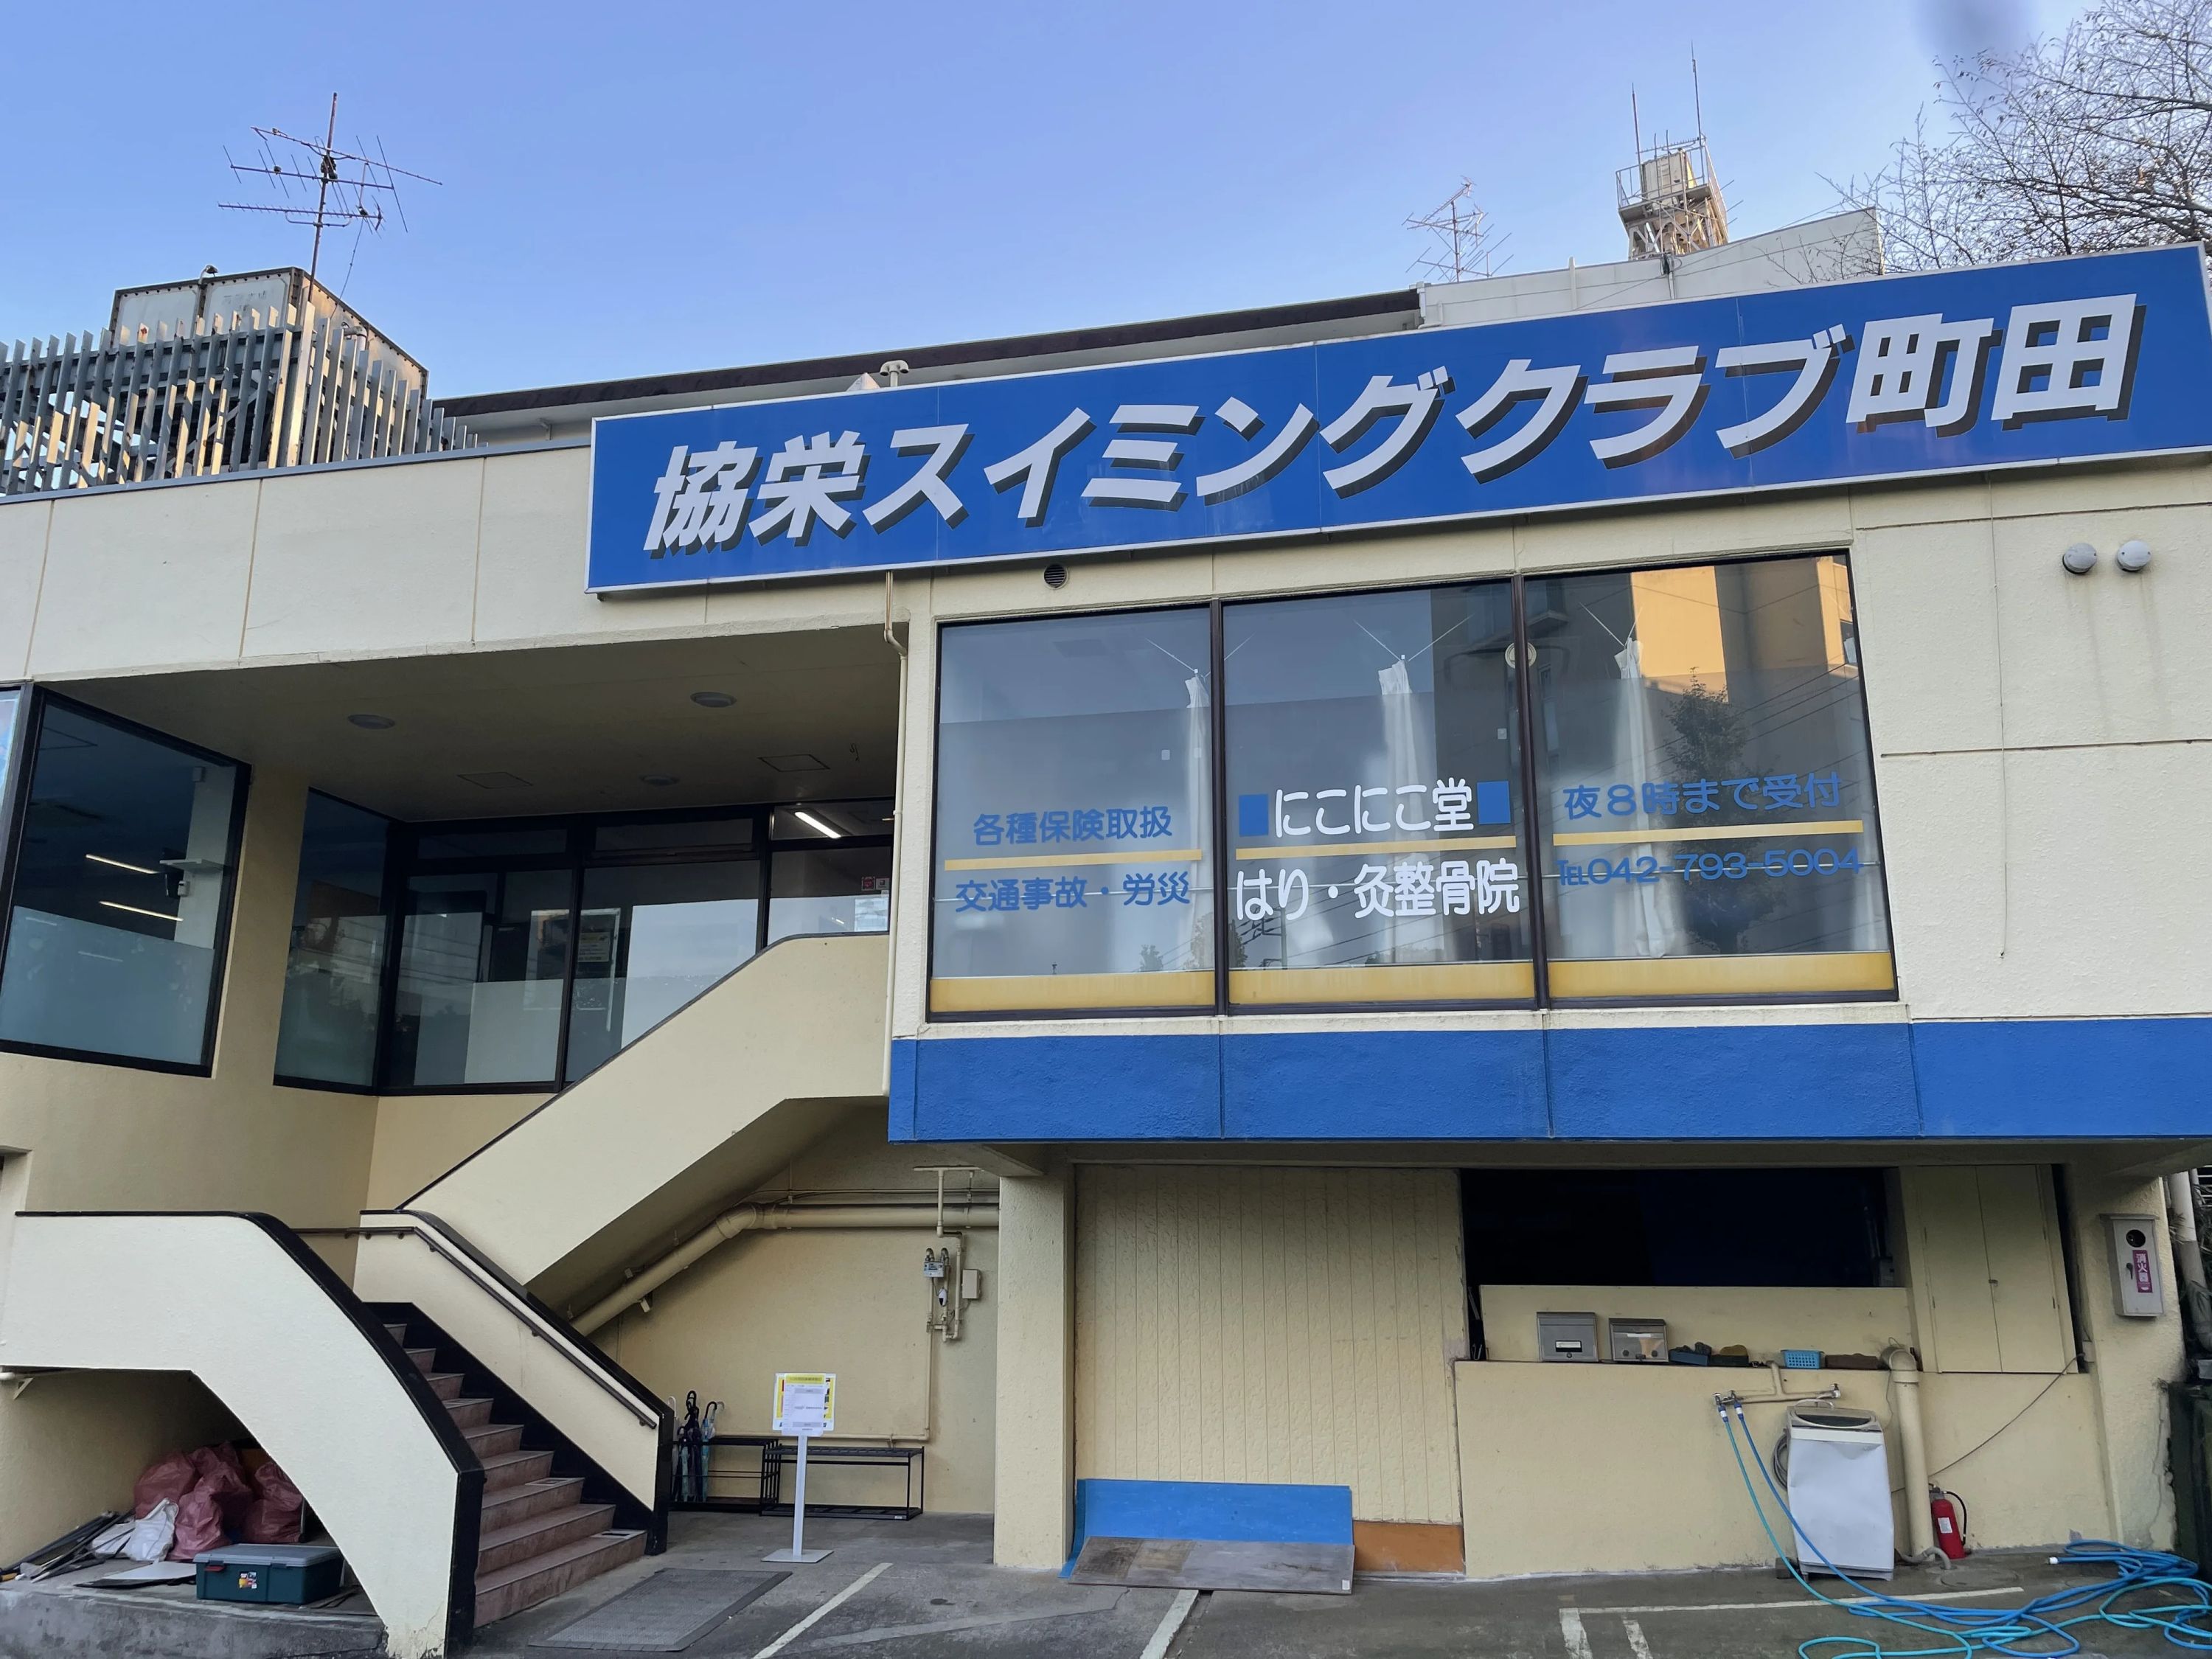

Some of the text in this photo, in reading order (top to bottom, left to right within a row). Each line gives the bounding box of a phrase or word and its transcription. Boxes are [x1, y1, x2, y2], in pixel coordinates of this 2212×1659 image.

[643, 293, 2143, 556] 協栄スイミングクラブ町田
[1275, 777, 1474, 838] にこにこ堂
[1562, 771, 1842, 820] 夜8時まで受付
[973, 805, 1172, 846] 各種保険取扱
[955, 871, 1191, 913] 交通事故・労災
[1236, 858, 1520, 921] はり・灸整骨院
